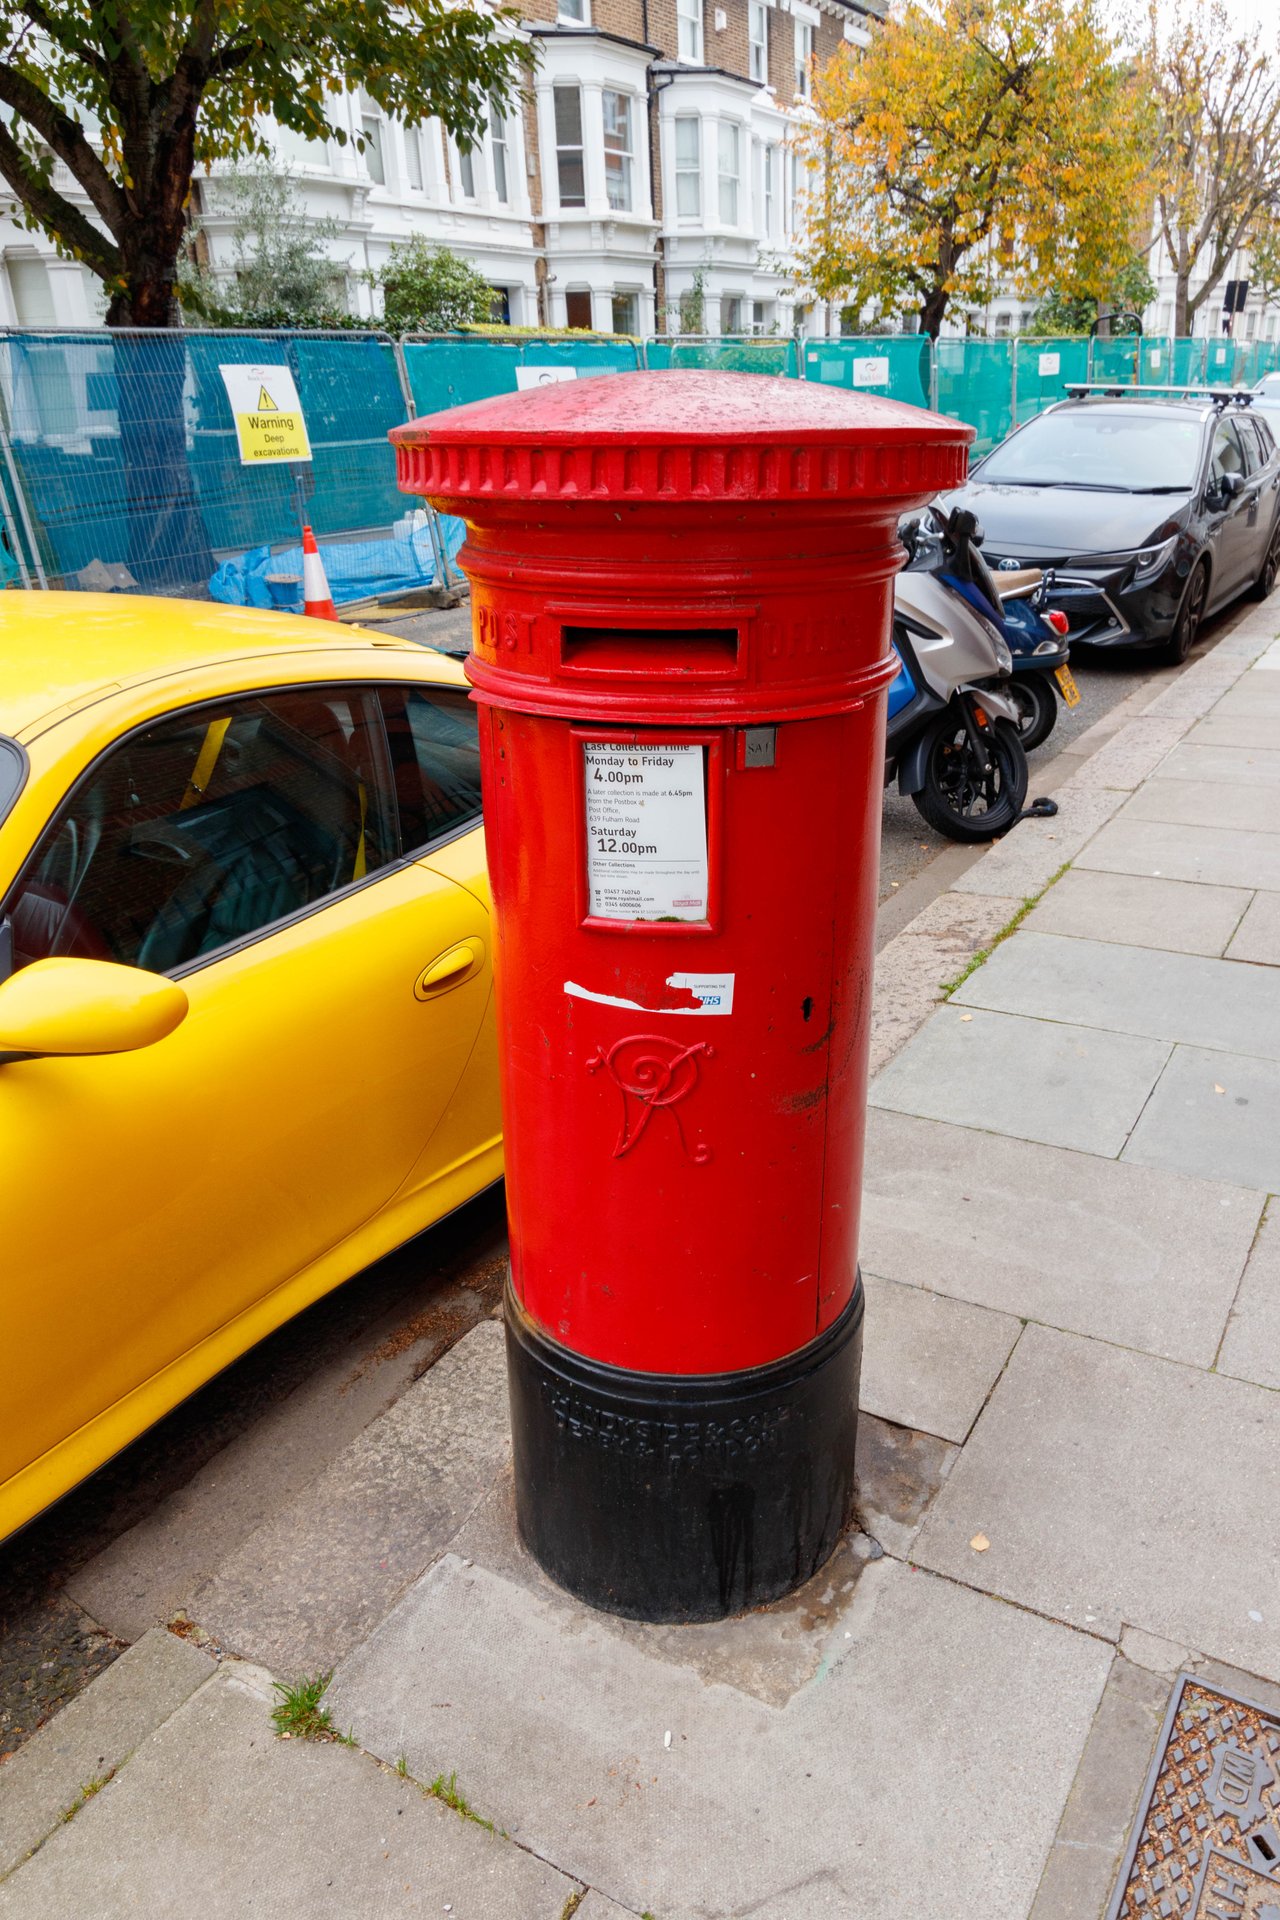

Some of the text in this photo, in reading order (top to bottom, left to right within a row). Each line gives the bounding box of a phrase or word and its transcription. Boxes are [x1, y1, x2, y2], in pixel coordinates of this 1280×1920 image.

[248, 416, 294, 431] Warning
[264, 434, 285, 443] Deep
[253, 446, 299, 457] excavations
[478, 605, 537, 656] POST
[586, 755, 674, 768] Monday to Friday
[594, 767, 644, 785] 4.00pm
[668, 789, 693, 798] 6.45pm
[588, 797, 602, 805] from
[614, 798, 637, 806] Postbox
[589, 806, 601, 814] Post
[625, 816, 640, 824] Road
[590, 826, 637, 839] Saturday
[597, 838, 657, 856] 12.00pm
[605, 895, 655, 903] www.royalmail.com
